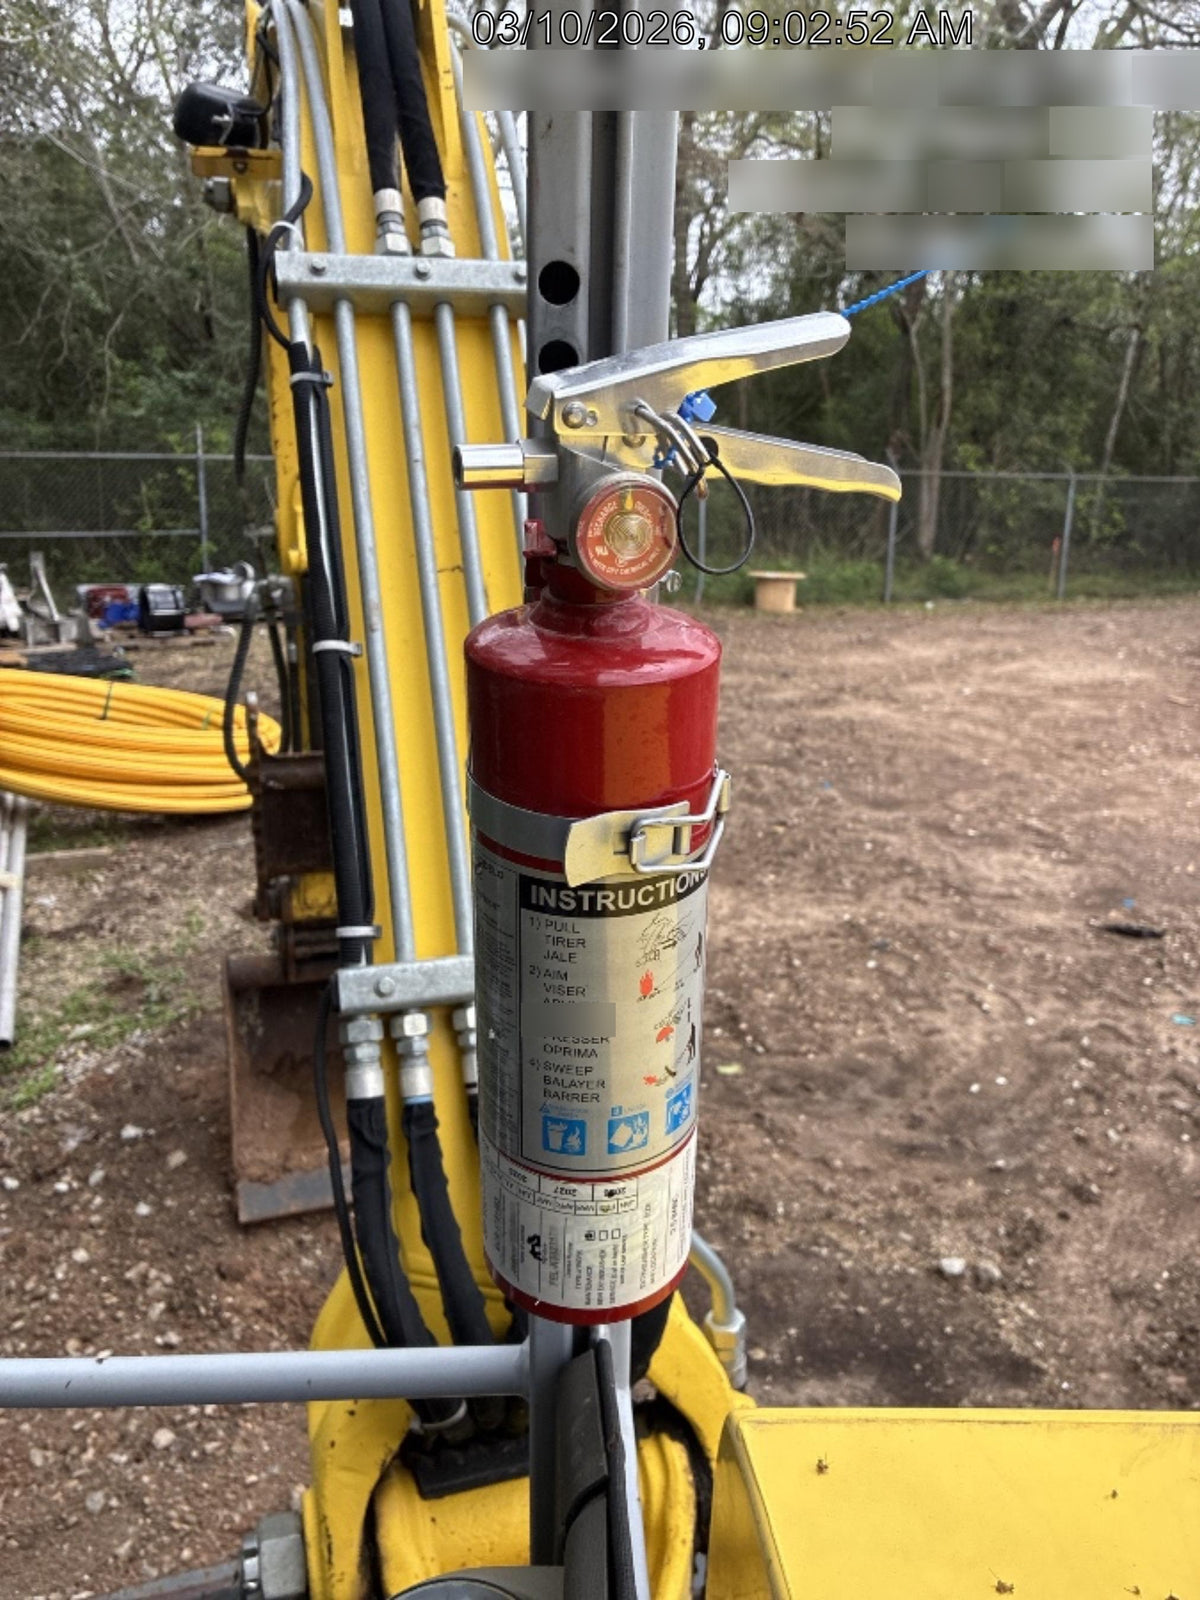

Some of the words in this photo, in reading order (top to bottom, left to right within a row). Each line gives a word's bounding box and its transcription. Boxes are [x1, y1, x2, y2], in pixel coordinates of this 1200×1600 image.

[530, 871, 707, 912] INSTRUCTION
[545, 918, 581, 934] PULL
[545, 934, 587, 949] TIRER
[543, 949, 578, 964] JALE
[529, 964, 541, 979] 2)
[543, 968, 568, 981] AIM
[543, 982, 587, 997] VISER
[543, 1043, 599, 1059] OPRIMA
[543, 1061, 594, 1077] SWEEP
[543, 1075, 606, 1091] BALAYER
[543, 1088, 601, 1104] BARRER
